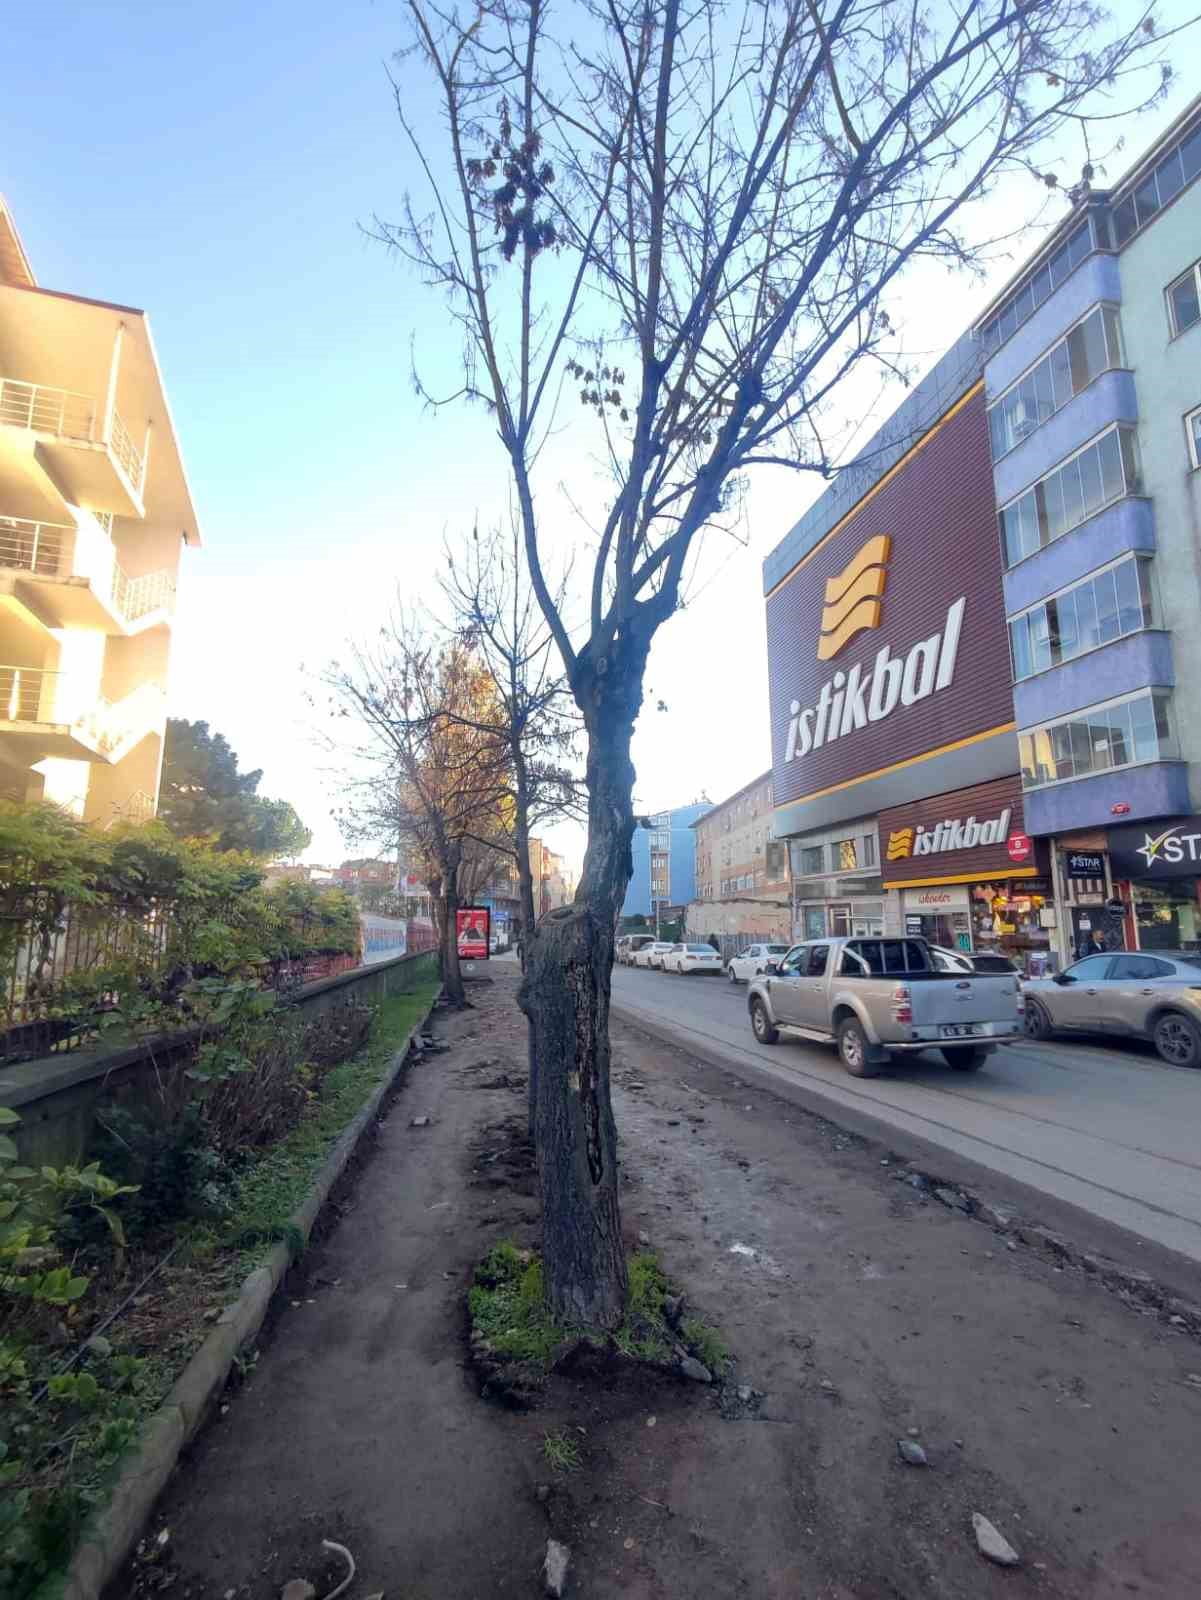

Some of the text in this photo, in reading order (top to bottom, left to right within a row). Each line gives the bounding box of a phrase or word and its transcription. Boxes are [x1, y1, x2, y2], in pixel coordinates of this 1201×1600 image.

[784, 596, 966, 763] istikbal
[912, 808, 1012, 856] istikbal
[1163, 833, 1201, 862] ST
[1077, 857, 1101, 868] STAR
